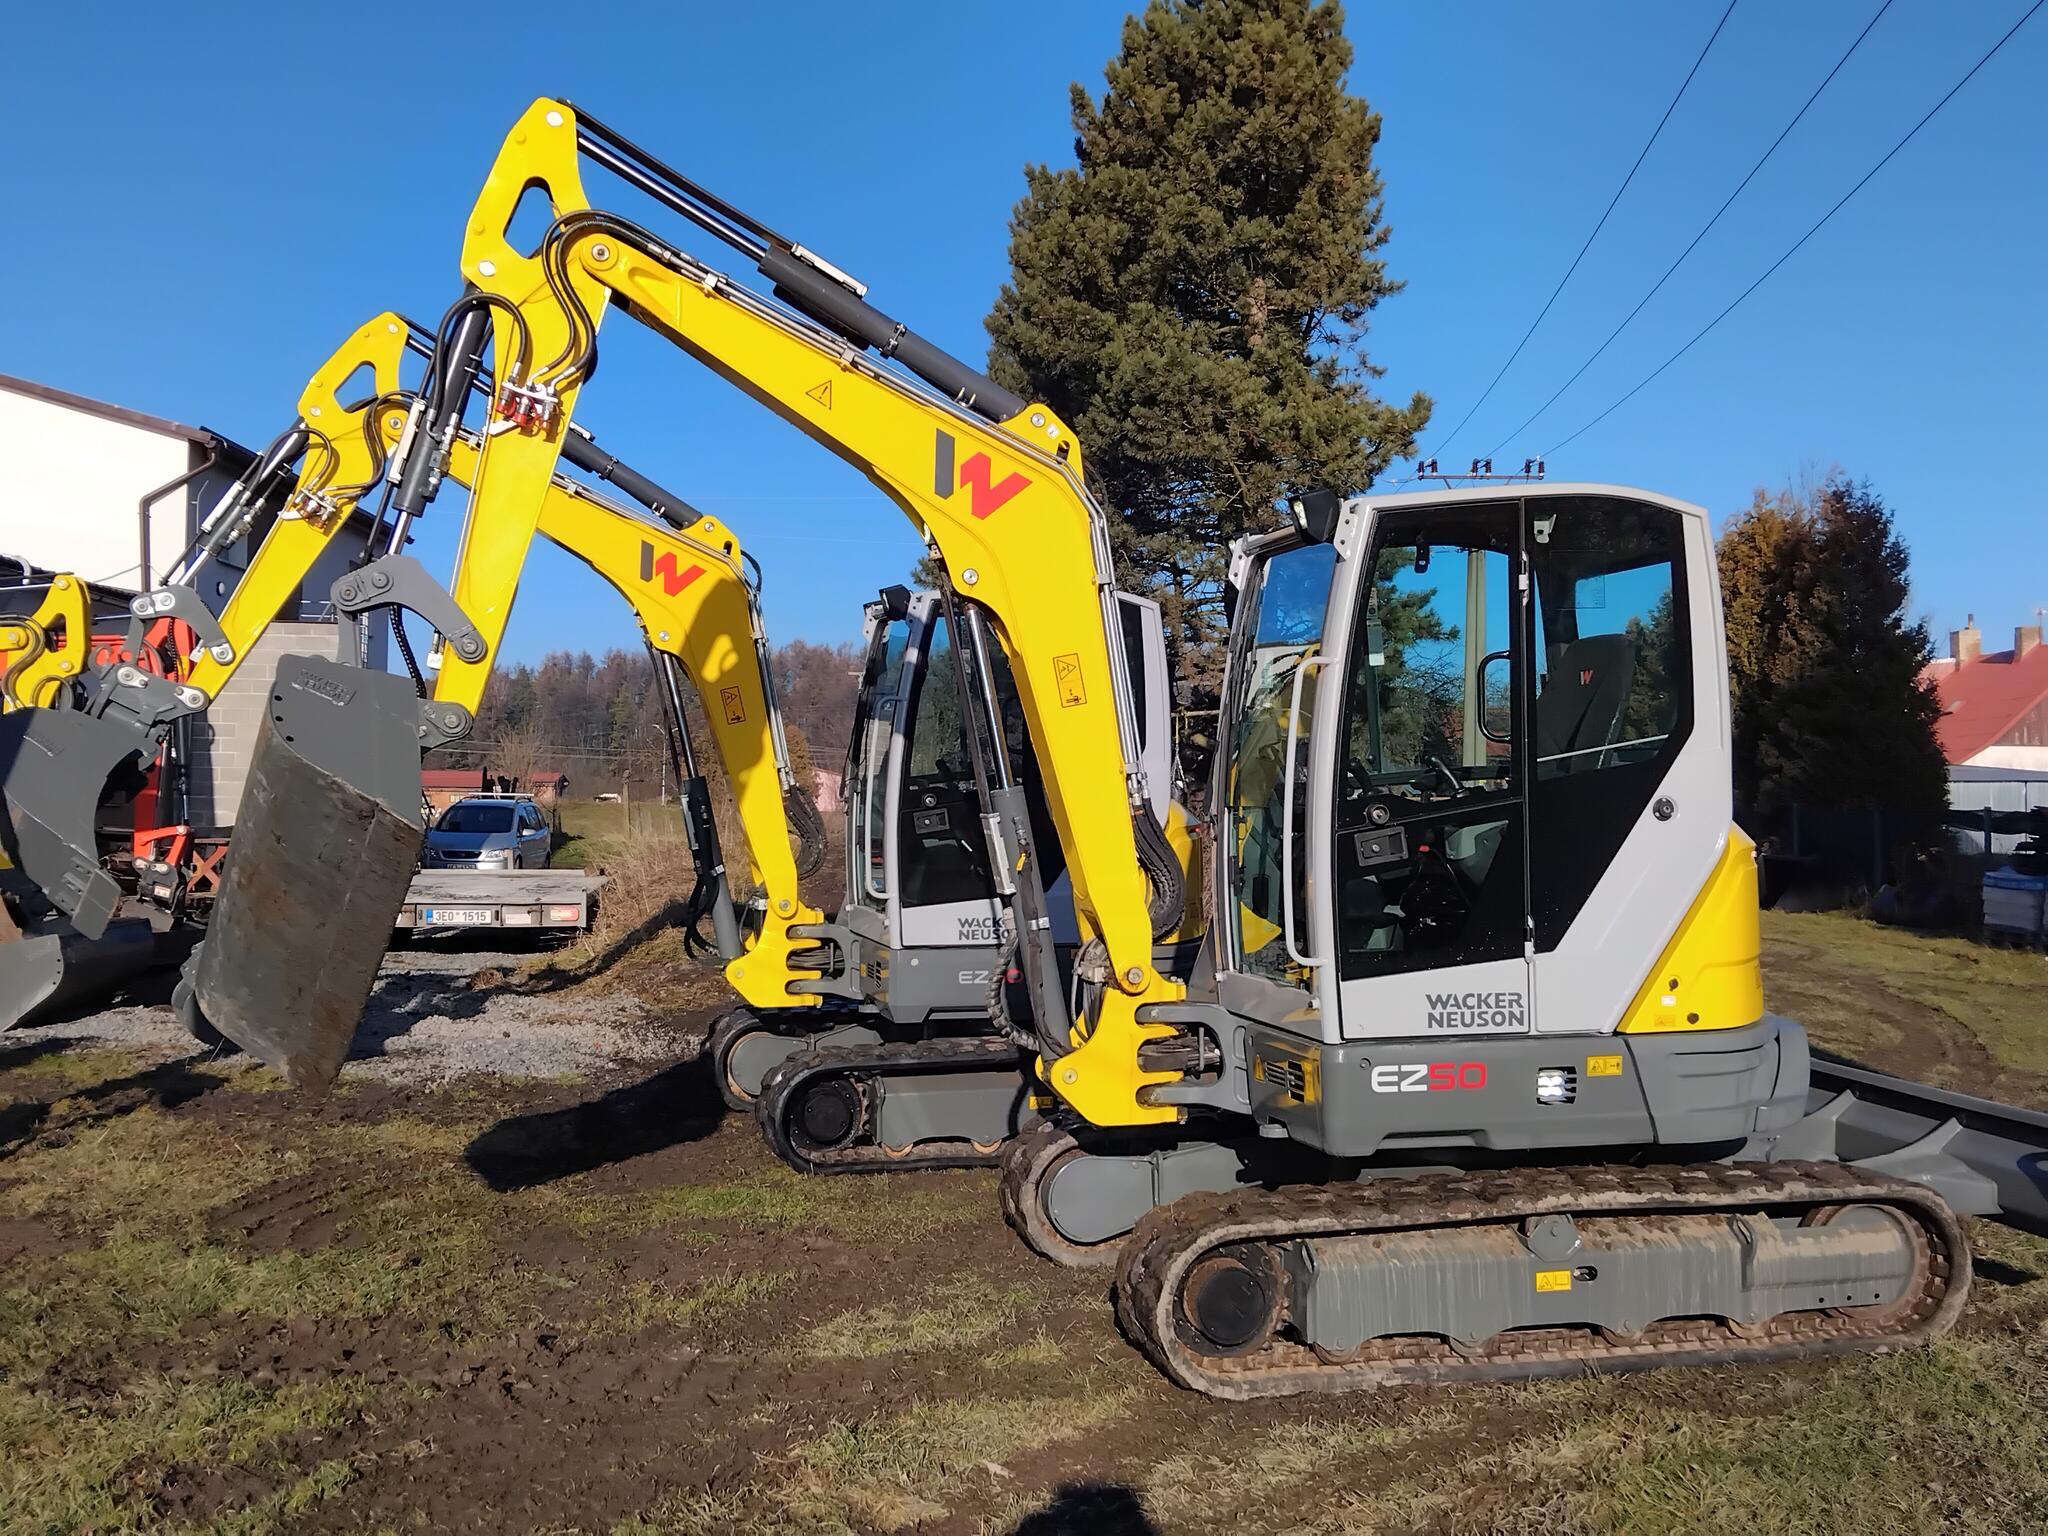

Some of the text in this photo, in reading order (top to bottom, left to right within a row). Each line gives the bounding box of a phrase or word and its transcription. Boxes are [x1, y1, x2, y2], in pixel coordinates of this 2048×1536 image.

[462, 911, 487, 922] 1515
[958, 917, 1005, 929] WACK
[958, 929, 1010, 941] NEUSO
[1425, 992, 1524, 1010] WACKER
[1427, 1010, 1524, 1029] NEUSON
[1371, 1061, 1487, 1093] EZ50
